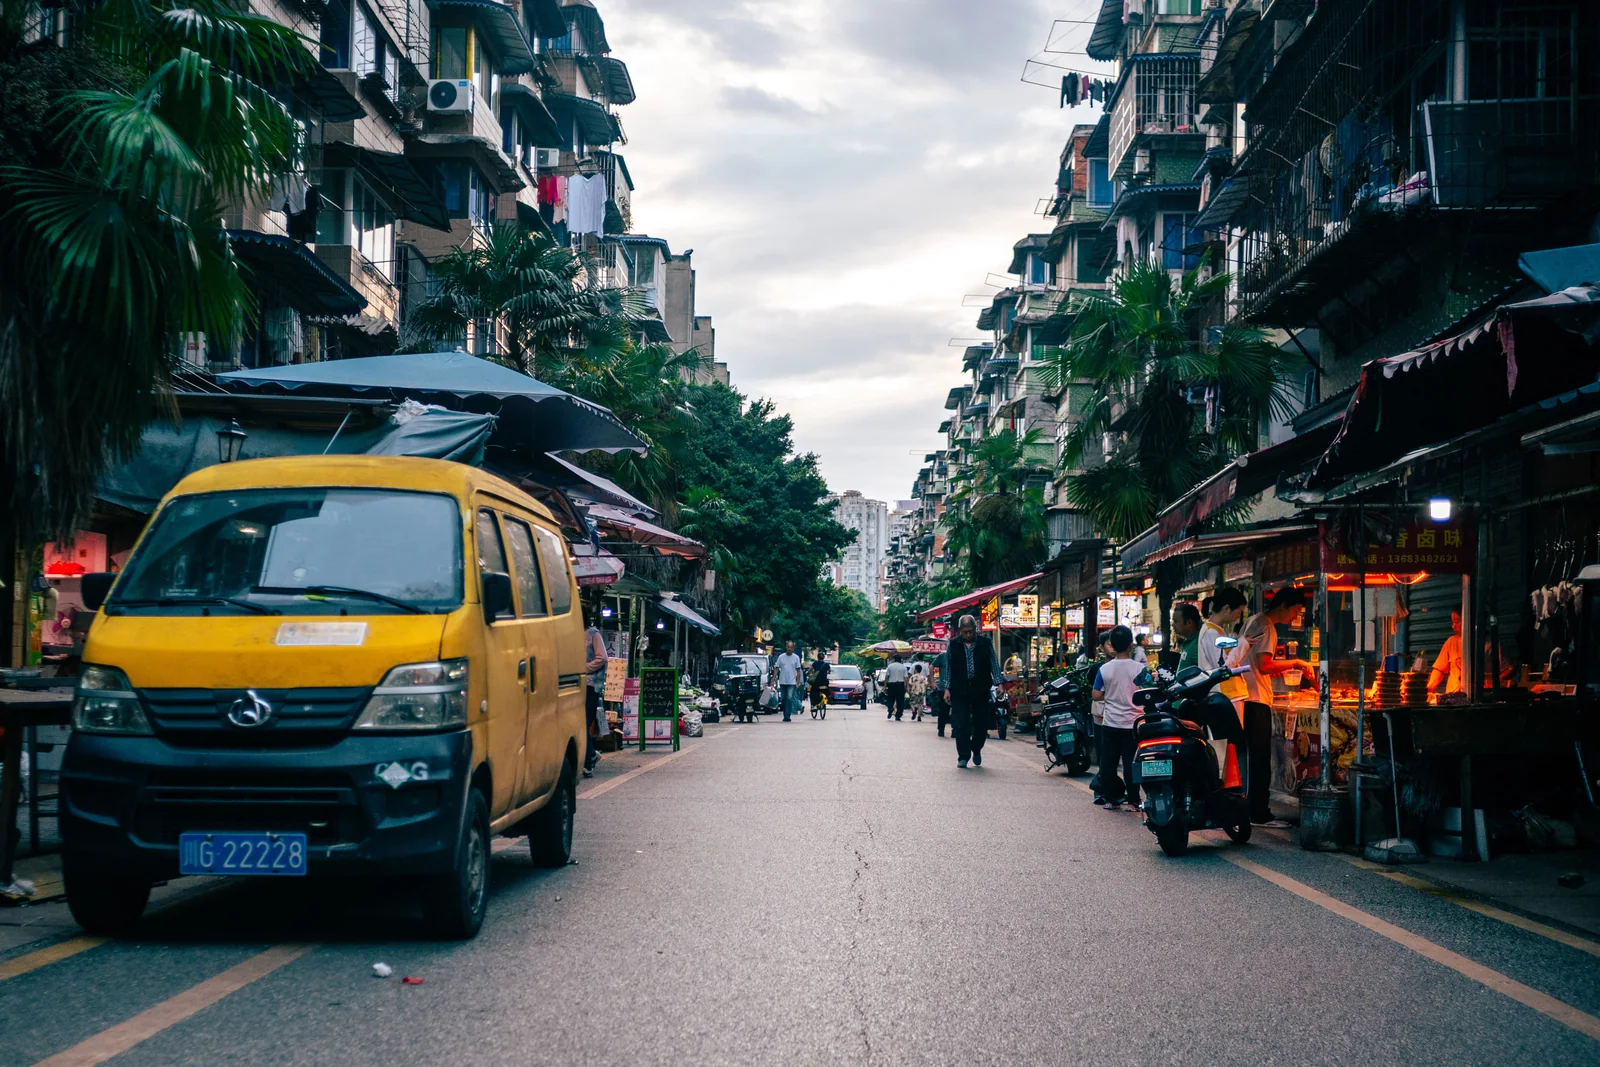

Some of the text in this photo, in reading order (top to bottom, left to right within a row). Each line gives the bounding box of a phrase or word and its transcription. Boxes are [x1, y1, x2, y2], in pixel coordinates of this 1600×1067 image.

[1369, 528, 1462, 548] 香卤味
[375, 761, 428, 781] CG
